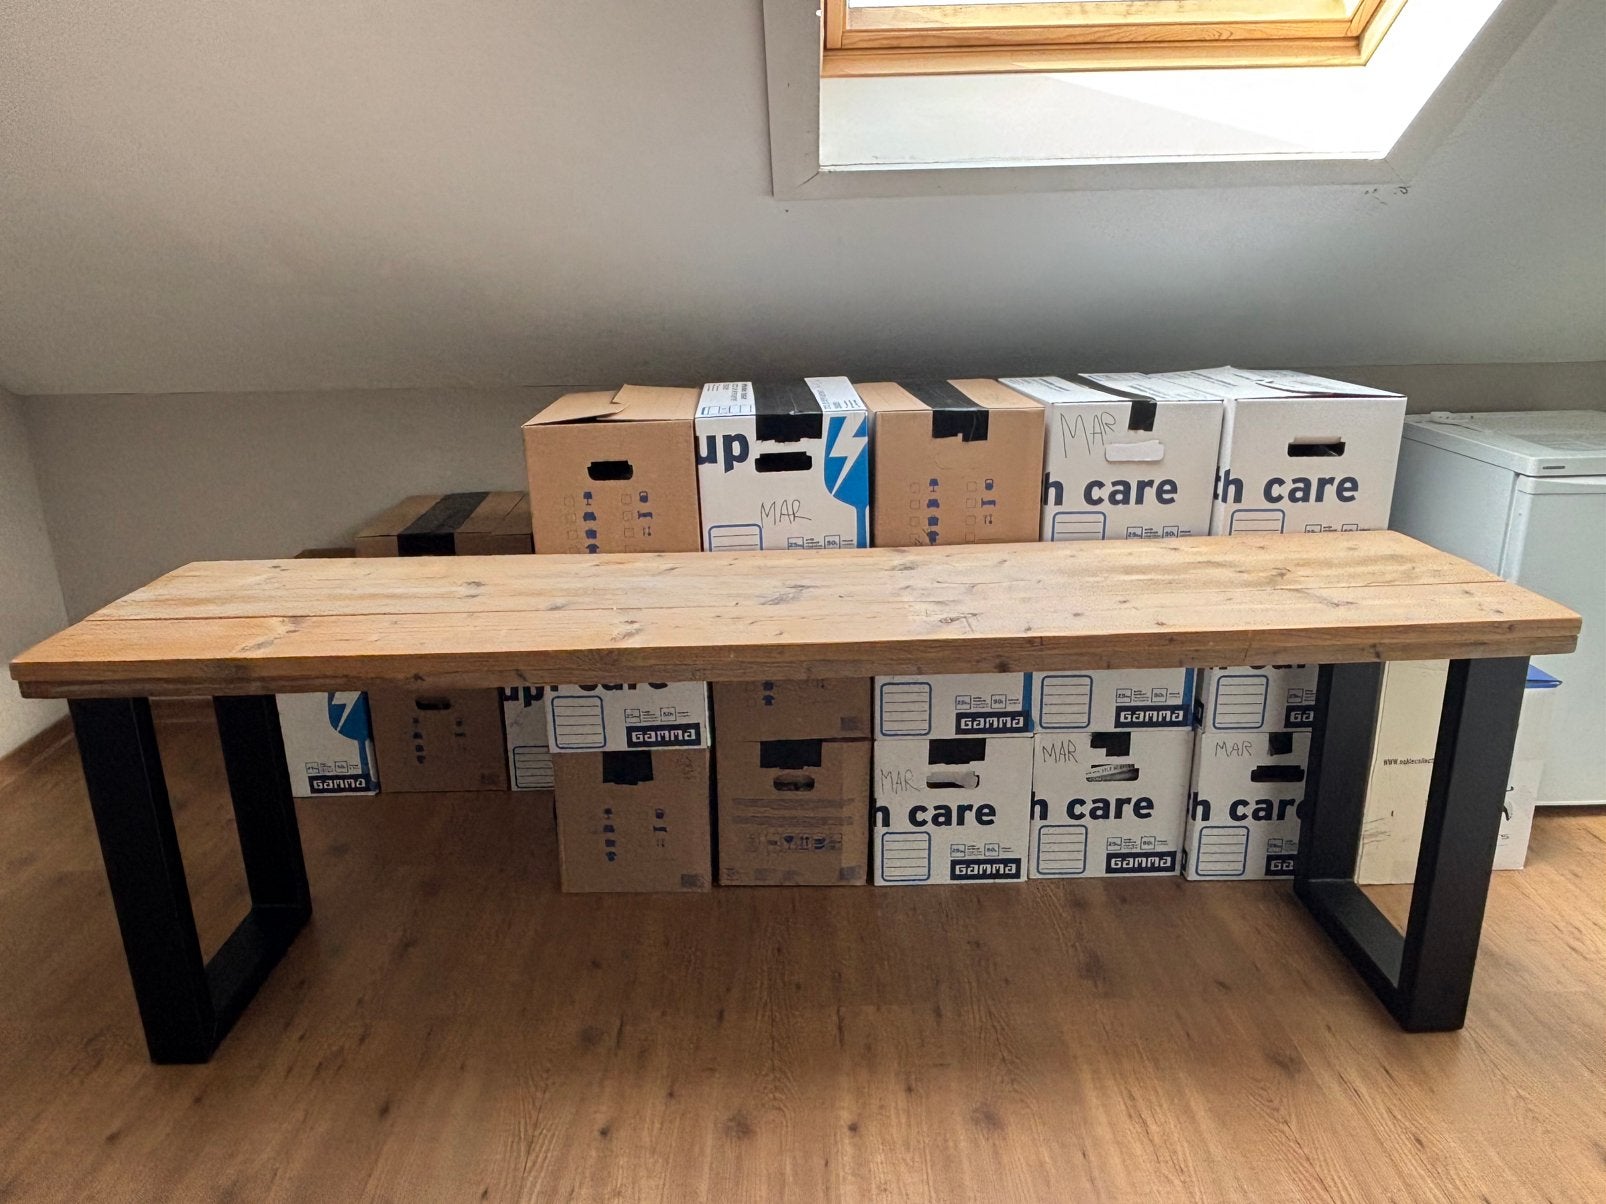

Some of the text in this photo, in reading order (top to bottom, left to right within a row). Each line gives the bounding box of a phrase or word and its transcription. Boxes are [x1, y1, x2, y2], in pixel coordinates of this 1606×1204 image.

[1060, 412, 1117, 458] MAR
[695, 434, 750, 473] up
[1083, 479, 1178, 506] care
[1263, 475, 1359, 504] care
[760, 500, 812, 529] MAR
[1042, 740, 1078, 764] MAR
[1214, 740, 1253, 757] MAR
[880, 768, 921, 795] MAR
[908, 803, 996, 828] care
[1066, 796, 1154, 821] care
[1229, 798, 1302, 822] car
